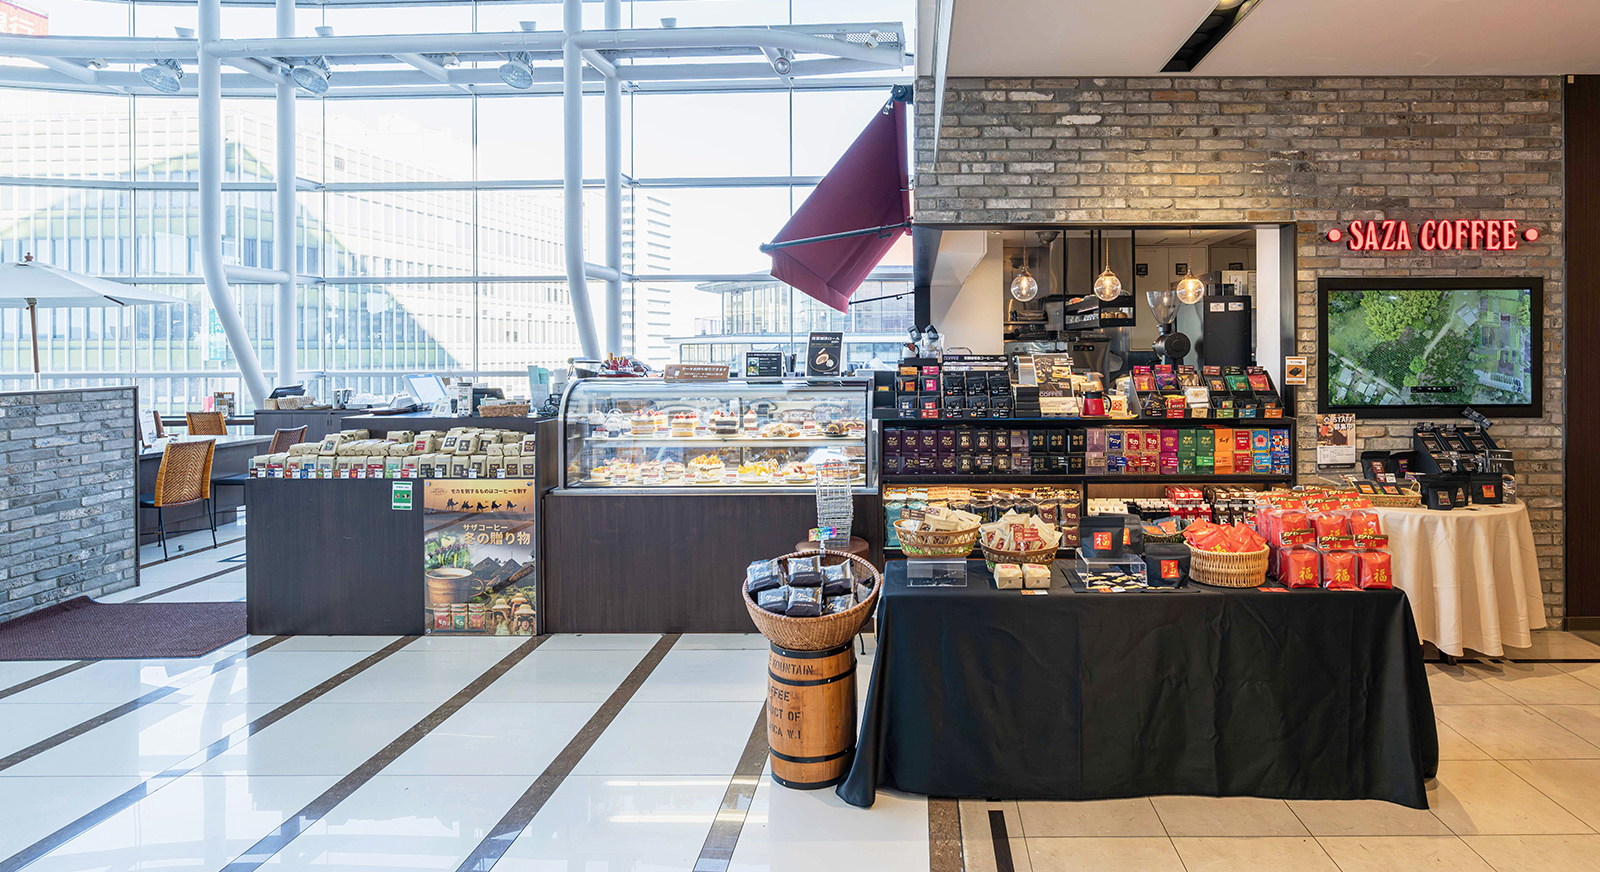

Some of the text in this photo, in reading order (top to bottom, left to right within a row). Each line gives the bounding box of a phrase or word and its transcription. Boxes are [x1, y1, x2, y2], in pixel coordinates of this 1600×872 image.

[1348, 219, 1518, 251] SAZA COFFEE
[1129, 438, 1139, 446] モカ
[1147, 438, 1157, 446] モカ
[463, 532, 531, 546] 冬の贈り物
[1096, 534, 1111, 547] 福
[1164, 562, 1178, 575] 福
[1299, 567, 1314, 581] 福
[1335, 568, 1350, 582] 福
[1373, 568, 1388, 582] 福
[772, 660, 813, 675] MOUNTAIN
[768, 685, 790, 702] FFEE
[788, 711, 801, 722] OF
